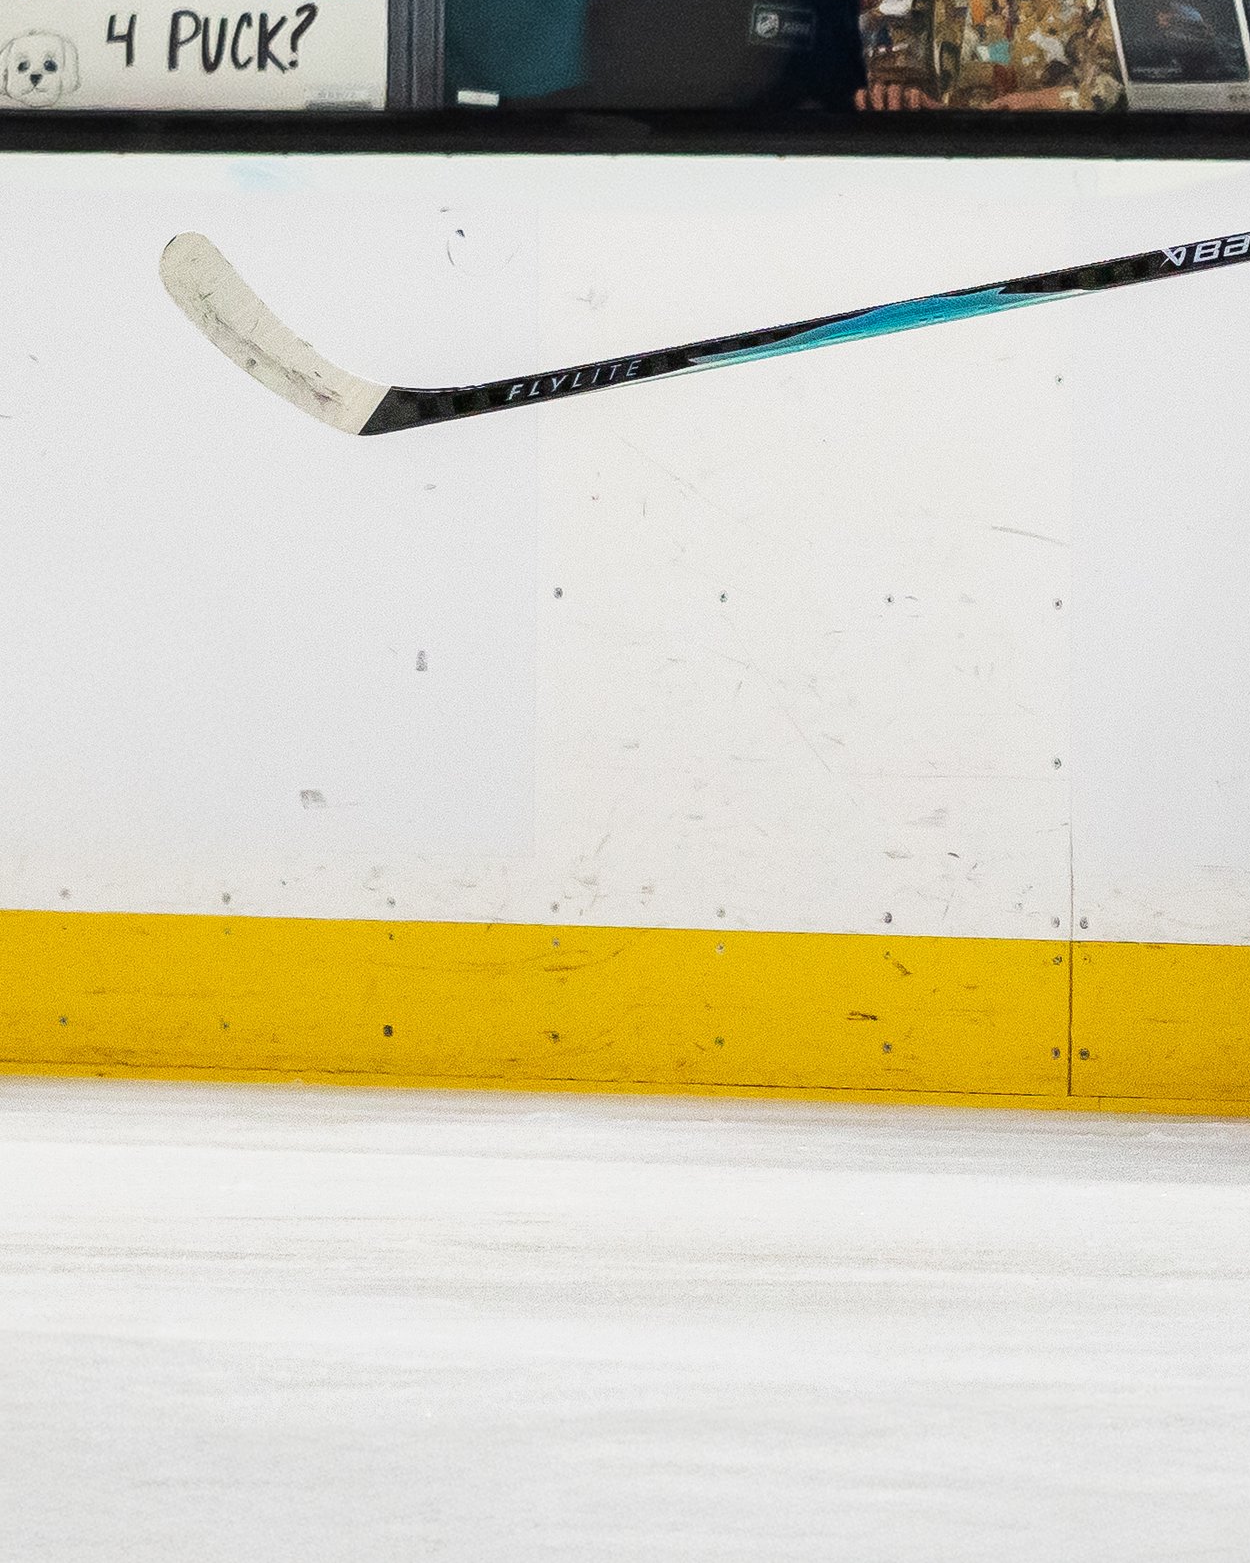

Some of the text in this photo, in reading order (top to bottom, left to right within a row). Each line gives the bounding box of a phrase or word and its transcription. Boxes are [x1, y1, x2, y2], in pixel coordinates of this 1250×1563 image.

[106, 1, 319, 75] 4 PUCK?
[507, 358, 644, 401] FLYLITE
